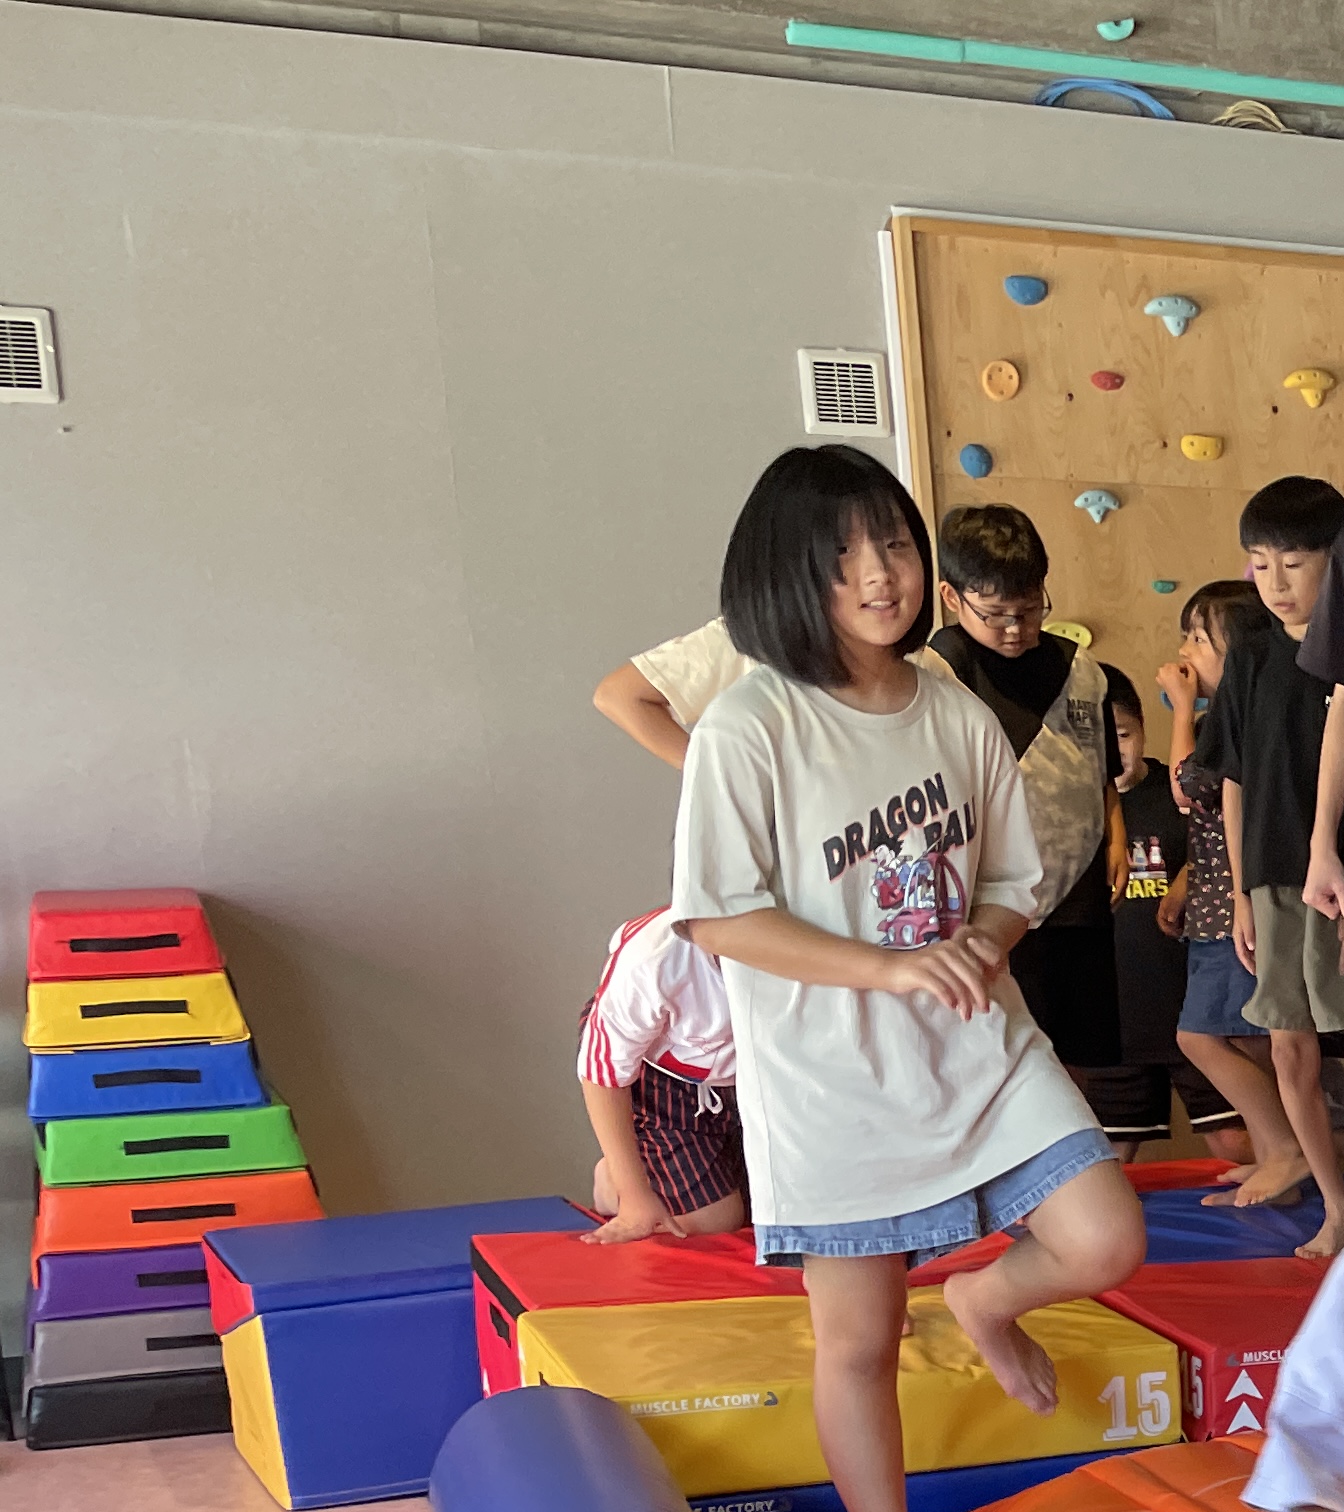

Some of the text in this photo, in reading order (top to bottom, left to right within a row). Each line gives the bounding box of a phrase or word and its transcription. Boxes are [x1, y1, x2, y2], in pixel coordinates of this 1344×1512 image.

[823, 772, 949, 882] DRAGON
[924, 795, 977, 852] BAL
[630, 1393, 761, 1415] MUSCLE FACTORY
[1097, 1371, 1172, 1442] 15
